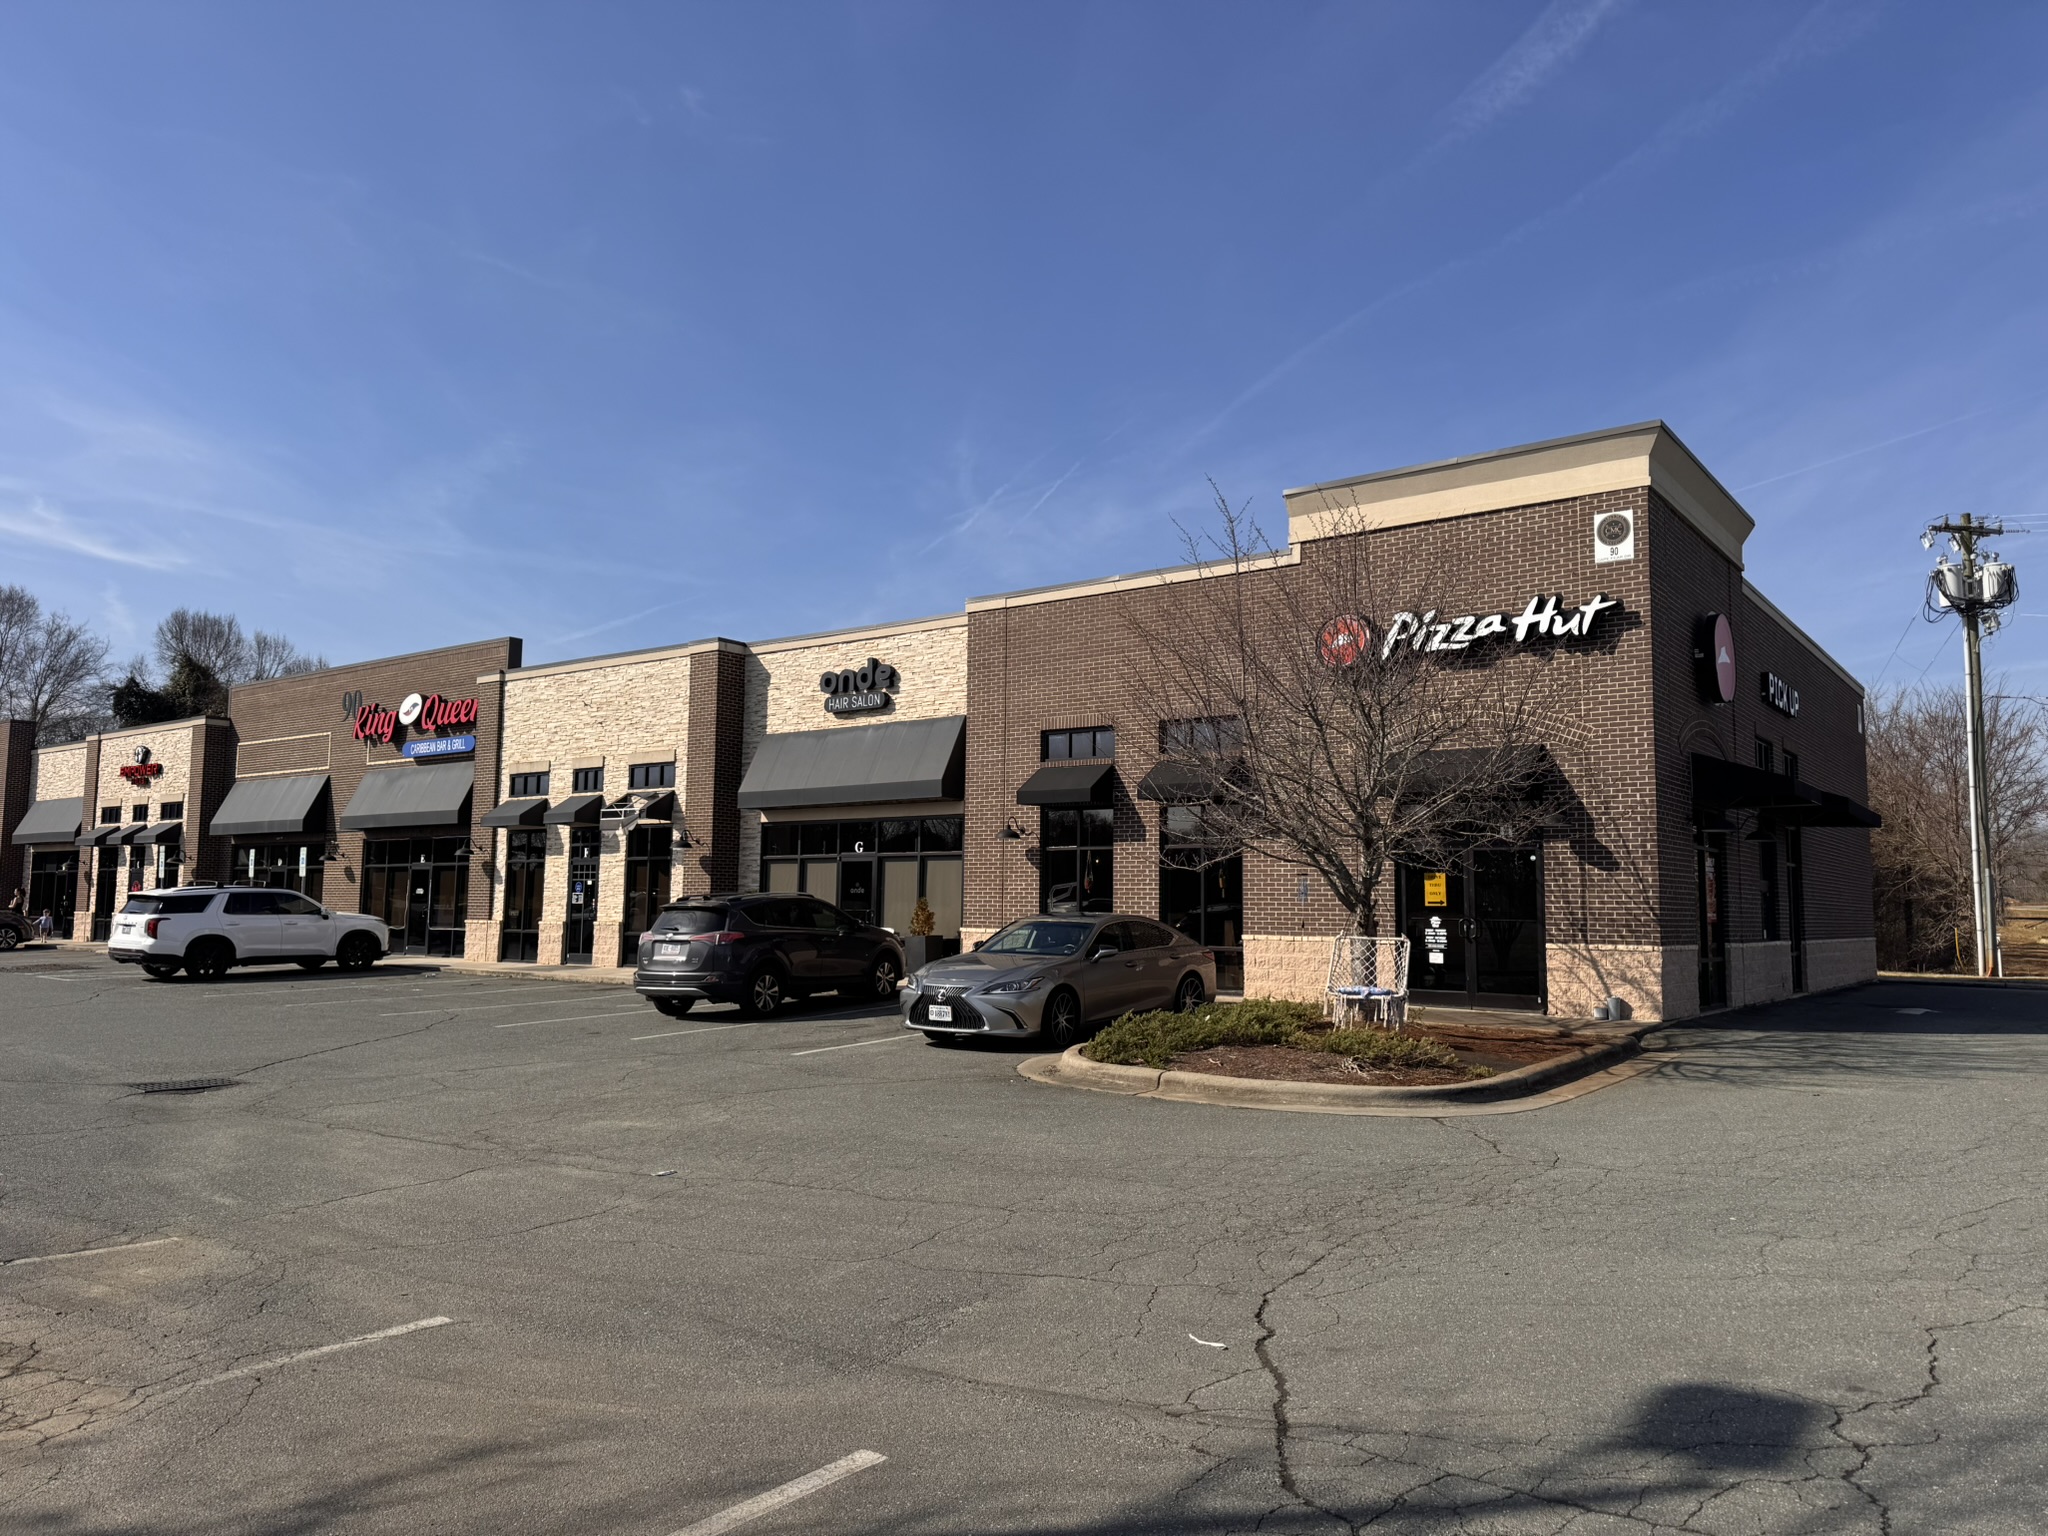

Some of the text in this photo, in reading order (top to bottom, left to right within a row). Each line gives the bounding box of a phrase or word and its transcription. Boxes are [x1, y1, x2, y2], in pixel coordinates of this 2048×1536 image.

[1610, 547, 1618, 556] 90
[1381, 594, 1617, 661] Pizza Hut
[820, 657, 892, 694] onde
[828, 694, 881, 711] HAIR SALON
[1768, 672, 1799, 718] PICK UP
[353, 703, 398, 742] King
[410, 738, 466, 755] CARIBBEAN BAR & GRILL
[120, 763, 159, 777] EMPOWER
[854, 841, 864, 854] G
